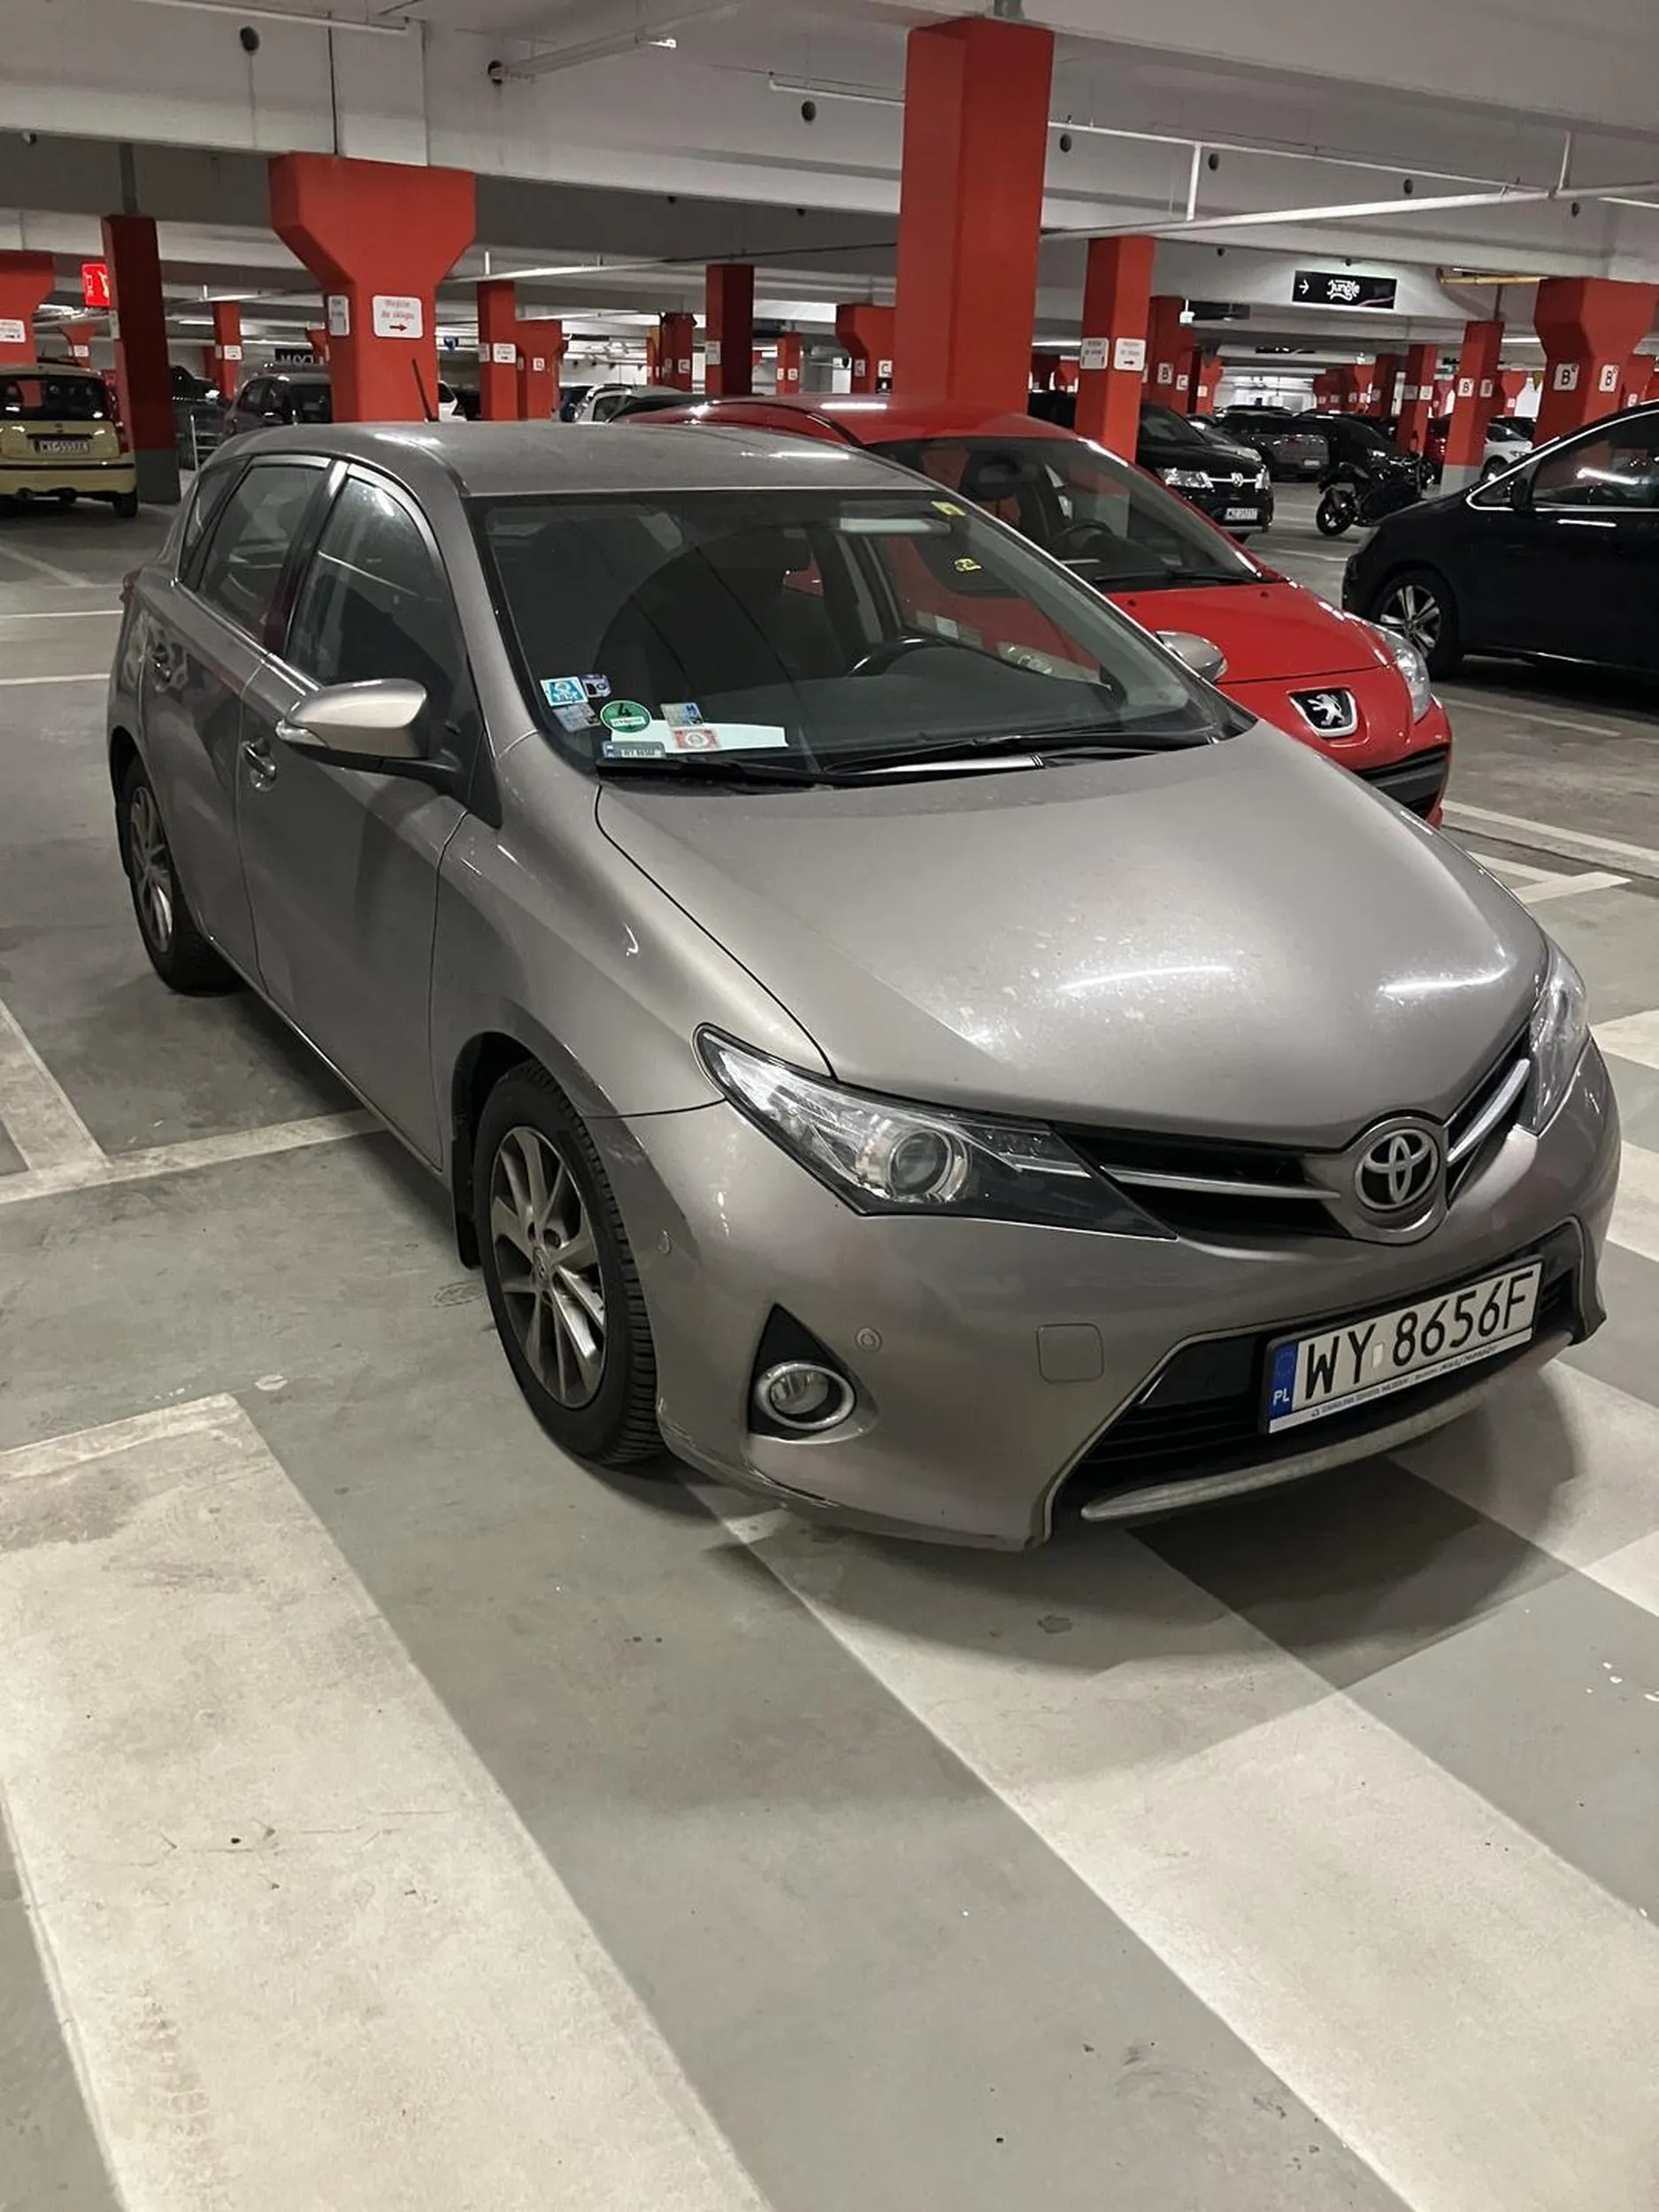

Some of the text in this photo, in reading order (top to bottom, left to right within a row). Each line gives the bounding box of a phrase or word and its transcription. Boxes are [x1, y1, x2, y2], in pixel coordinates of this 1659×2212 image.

[1560, 369, 1571, 386] B
[1604, 370, 1614, 387] B
[618, 703, 633, 717] 4
[1305, 1322, 1377, 1400] WY
[1392, 1270, 1534, 1368] 8656F
[1272, 1387, 1290, 1406] PL
